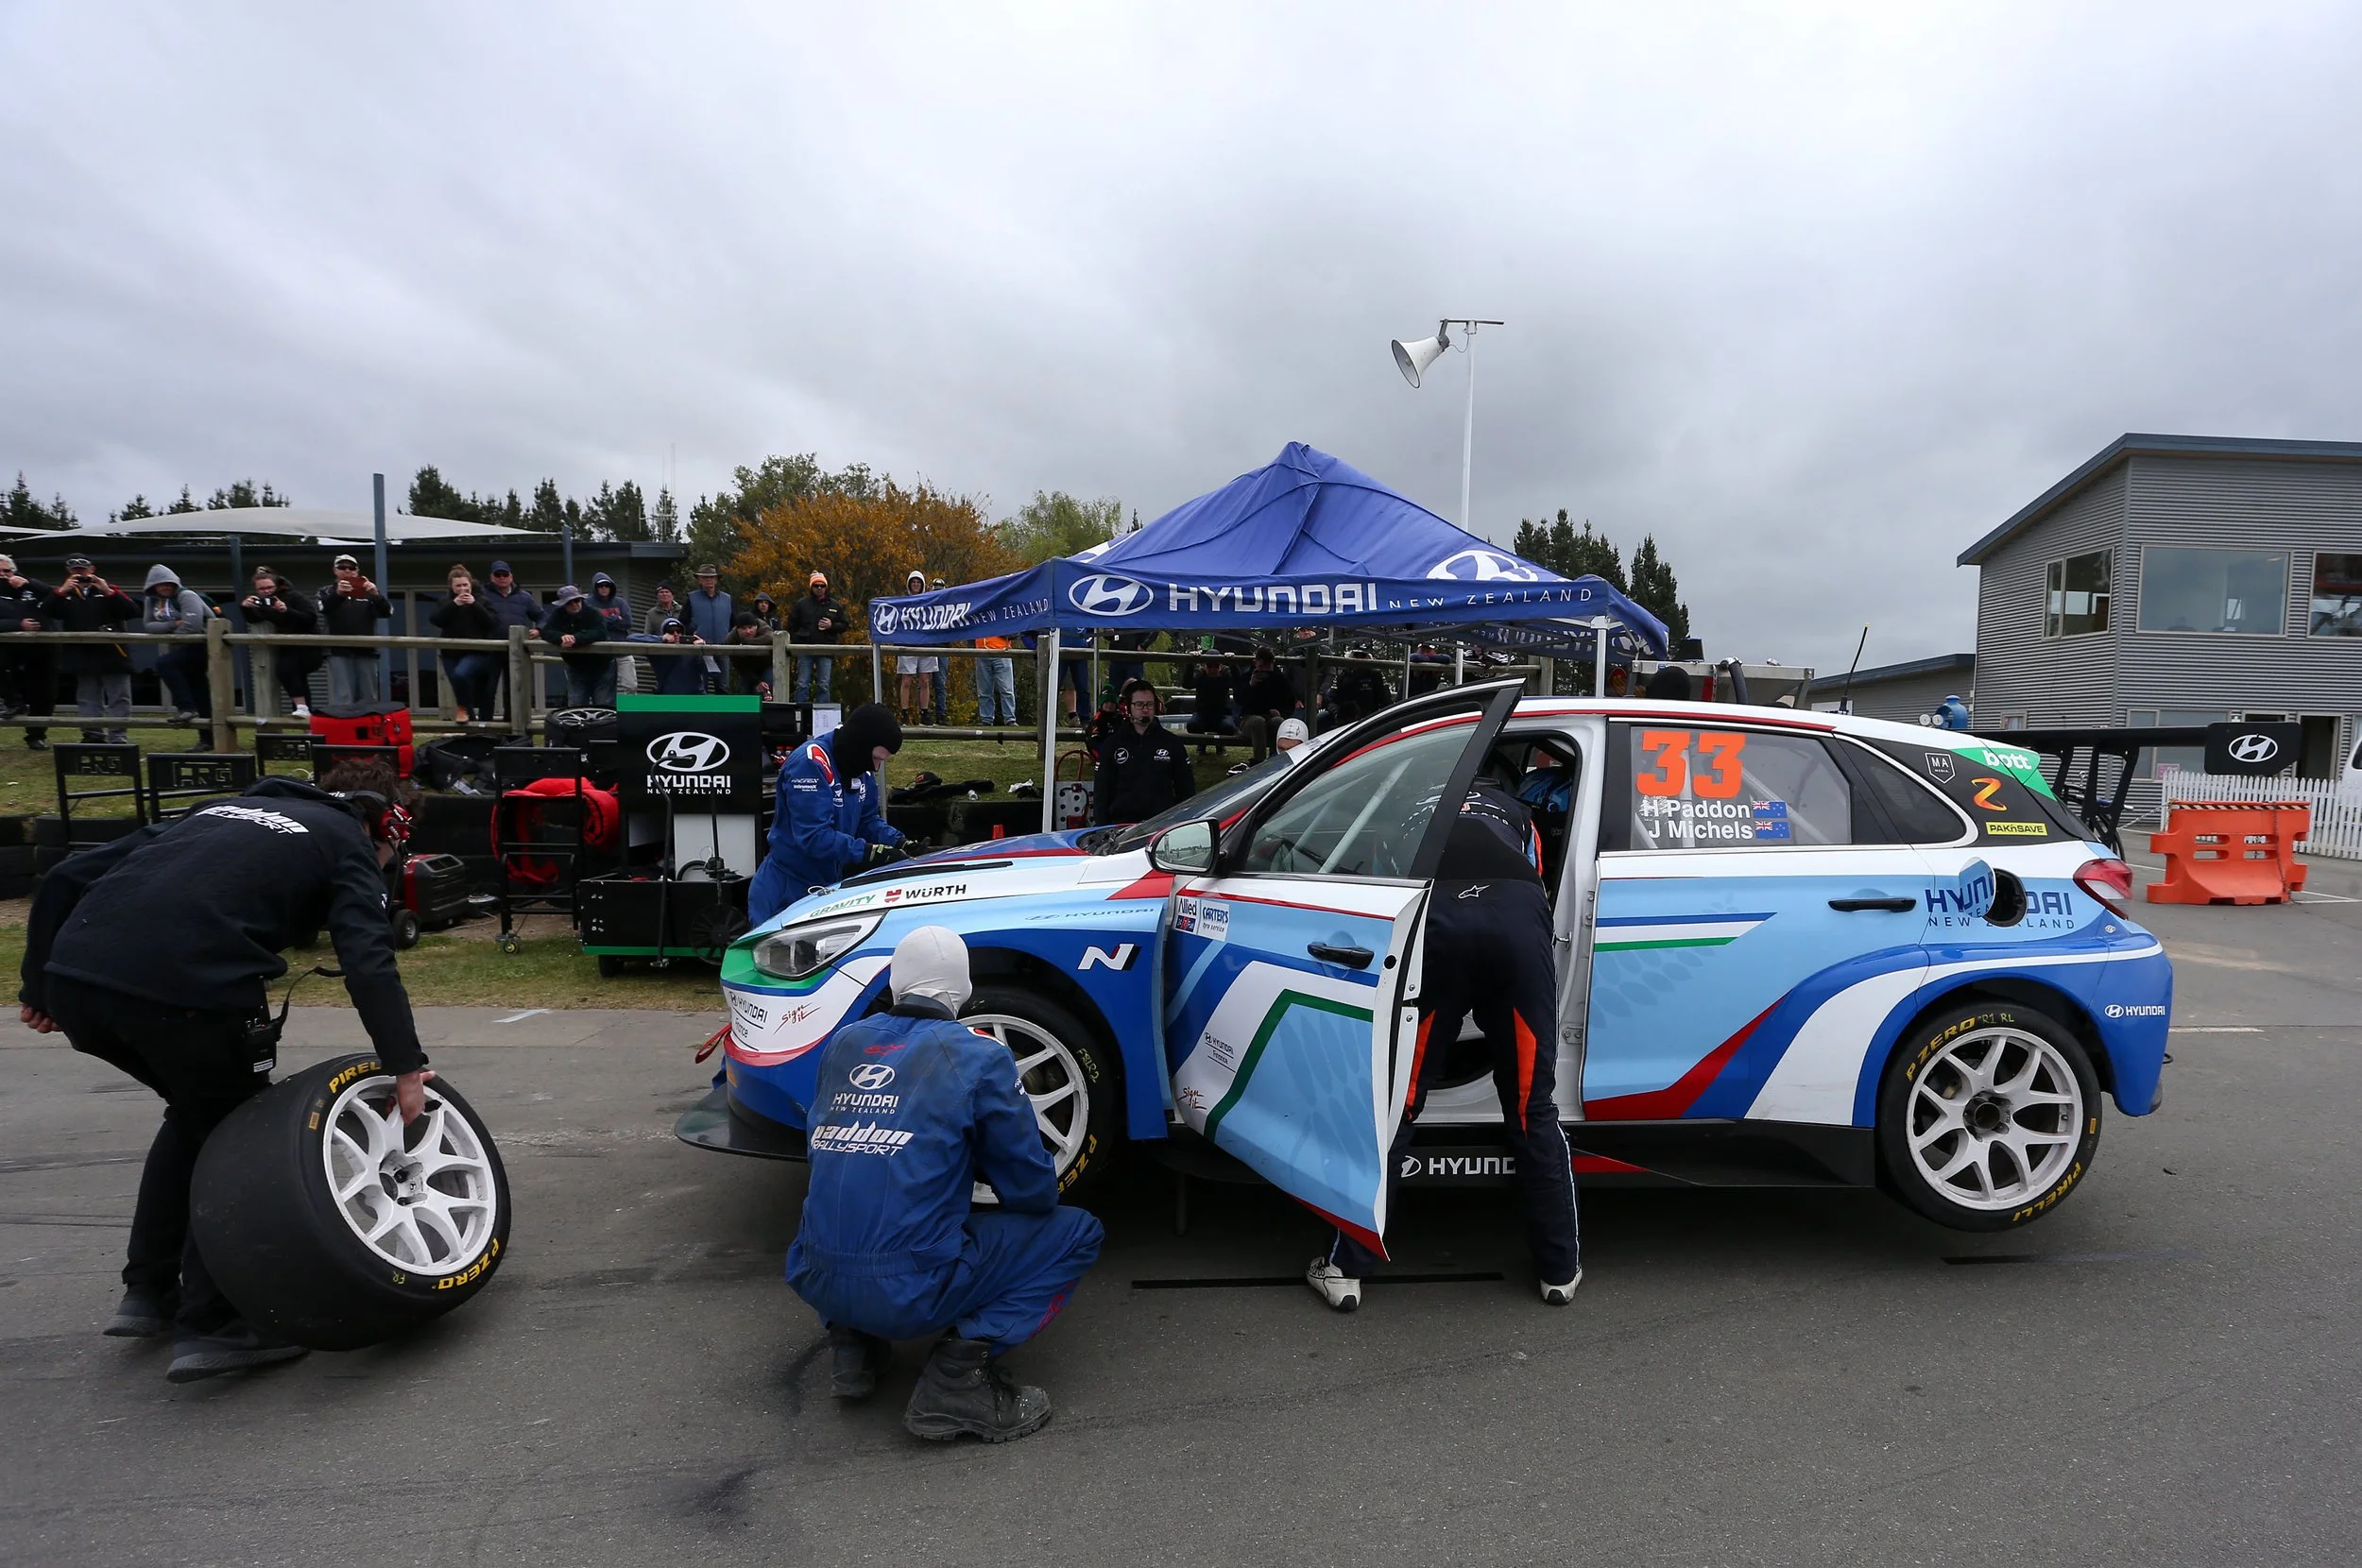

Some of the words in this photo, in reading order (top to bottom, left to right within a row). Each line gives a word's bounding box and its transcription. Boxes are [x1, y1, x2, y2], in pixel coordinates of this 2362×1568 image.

[1169, 582, 1378, 614] HYUNDAI
[1389, 597, 1444, 610] NEW
[1466, 588, 1592, 605] ZEALAND
[900, 602, 971, 631] HYUNDAI
[972, 610, 998, 625] NEW
[1002, 598, 1050, 620] ZEALAND
[1636, 730, 1746, 799] 33
[1981, 750, 2032, 770] bott
[646, 775, 731, 788] HYUNDAI
[1642, 799, 1659, 818] H
[1668, 799, 1751, 819] Paddon
[1648, 820, 1660, 839] J
[1669, 820, 1754, 840] Michels
[810, 894, 877, 918] GRAVITY
[1065, 908, 1155, 918] HYUNDAI
[1178, 897, 1198, 916] Allied
[1927, 917, 1972, 928] NEW
[2000, 1012, 2015, 1023] RL
[2125, 1005, 2165, 1016] HYUNDAI
[1906, 1062, 1916, 1082] P
[1917, 1016, 1976, 1065] ZERO
[329, 1061, 382, 1094] PIREL
[832, 1093, 899, 1108] HYUNDAI
[852, 1106, 896, 1115] ZEALAND
[813, 1139, 903, 1157] RALLYSPORT
[1429, 1157, 1516, 1175] HYUND
[2012, 1162, 2081, 1222] PIRELLI
[491, 1237, 500, 1257] P
[437, 1253, 491, 1289] ZERO
